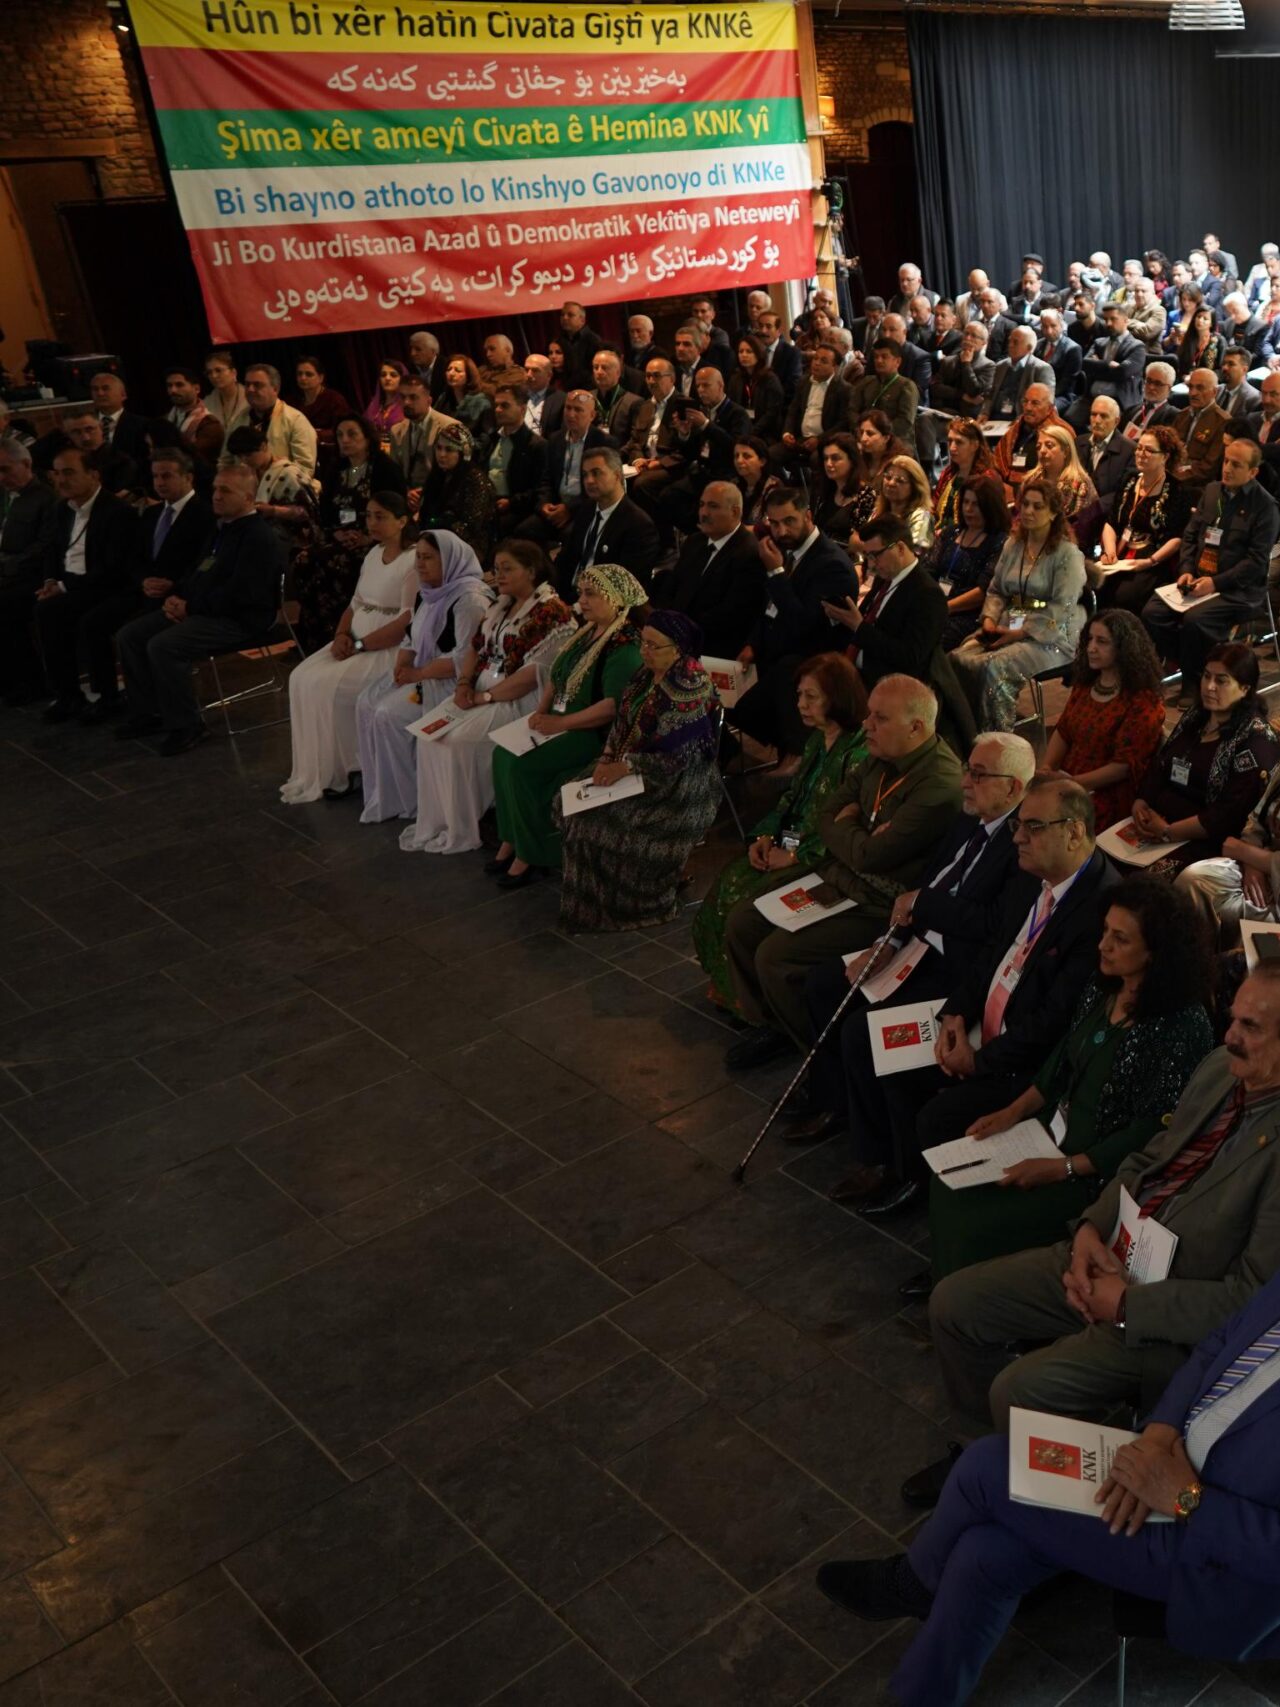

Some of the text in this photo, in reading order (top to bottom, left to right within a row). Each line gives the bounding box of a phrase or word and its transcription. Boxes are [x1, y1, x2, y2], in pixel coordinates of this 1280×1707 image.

[203, 0, 753, 45] Hûn bi xêr hatin Civata Giştî ya KNKê
[216, 105, 770, 160] Şima xêr ameyî Civata ê Hemina KNK yî
[214, 160, 785, 218] Bi shayno athoto lo Kinshyo Gavonoyo di KNKe
[212, 198, 801, 266] Ji Bo Kurdistana Azad û Demokratik Yekîtîya Neteweyî
[919, 1019, 932, 1043] KNK
[1124, 1240, 1137, 1272] KNK
[1081, 1447, 1097, 1484] KNK
